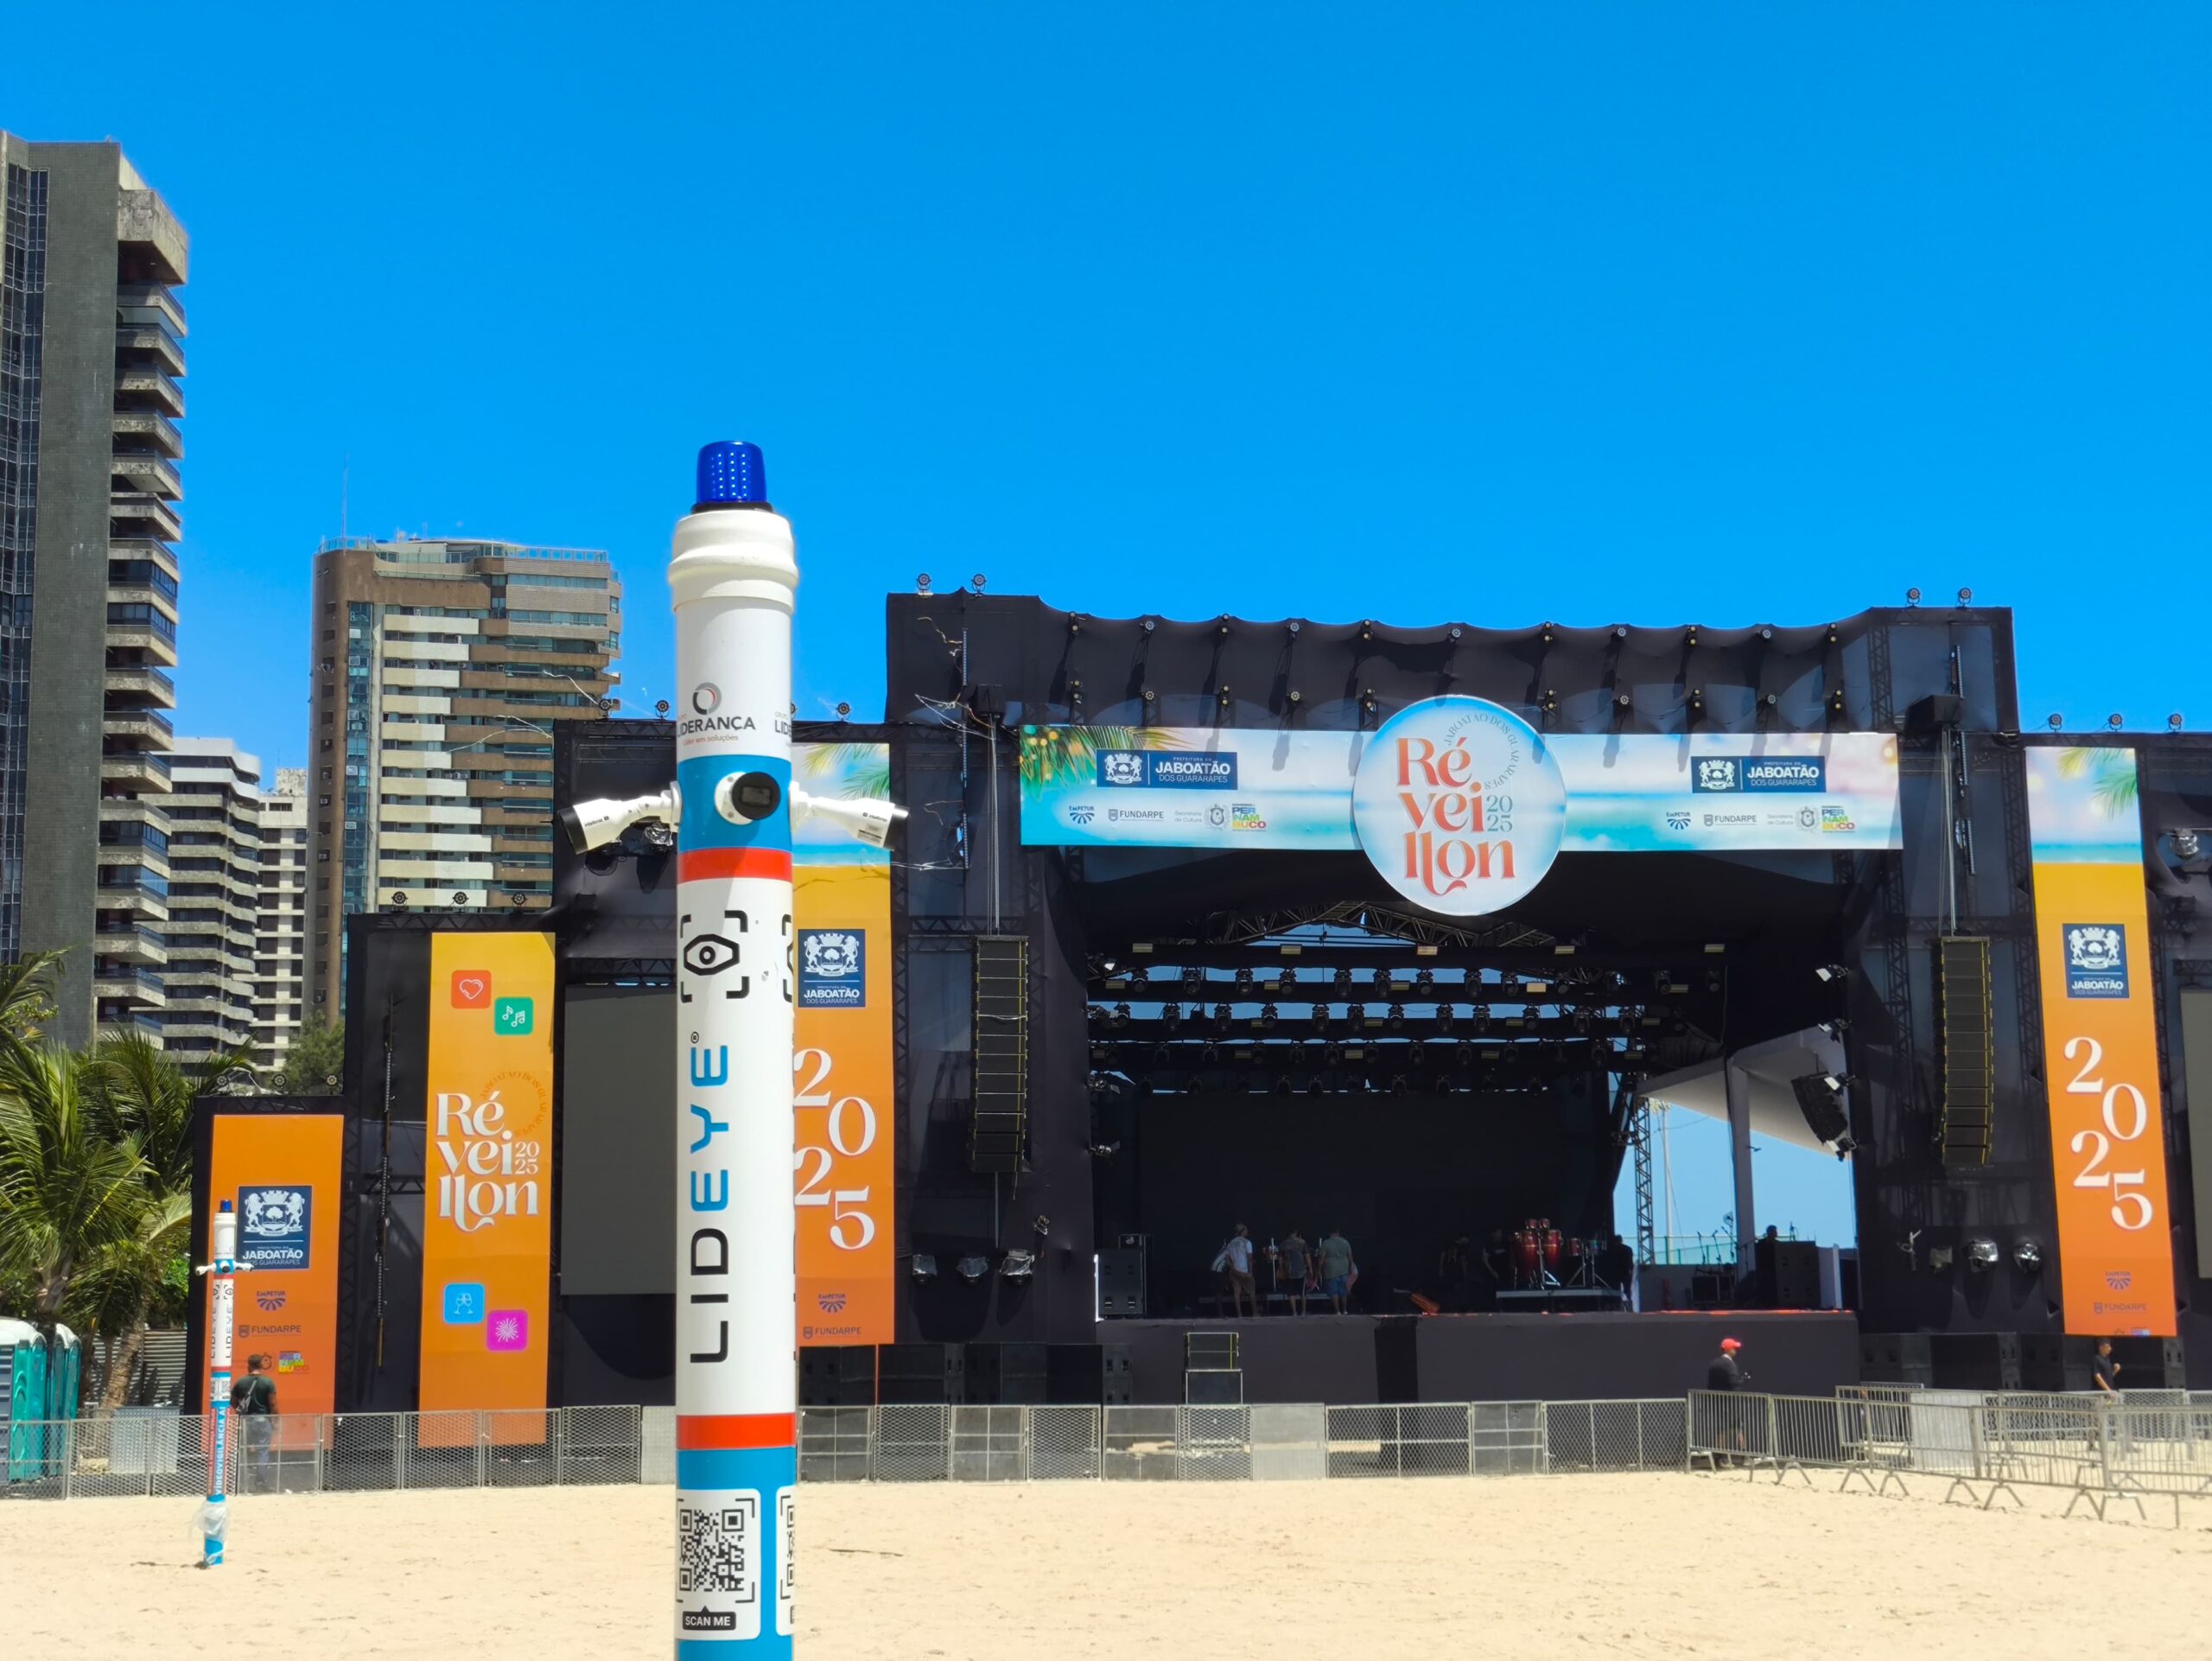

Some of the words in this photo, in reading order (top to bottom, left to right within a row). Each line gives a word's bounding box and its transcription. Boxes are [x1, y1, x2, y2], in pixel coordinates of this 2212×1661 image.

[1155, 760, 1230, 775] JABOATÃO
[1396, 736, 1472, 788] Ré
[1159, 773, 1175, 782] DOS
[1176, 774, 1229, 783] GUARARAPES
[1747, 764, 1820, 779] JABOATÃO
[1397, 781, 1484, 832] vei
[1486, 795, 1513, 812] 20
[1120, 810, 1164, 819] FUNDARPE
[1486, 814, 1513, 832] 25
[2071, 980, 2124, 990] JABOATÃO
[804, 988, 860, 998] JABOATÃO
[436, 1091, 505, 1136] Ré
[436, 1130, 513, 1175] vei
[515, 1141, 540, 1158] 20
[515, 1158, 539, 1175] 25
[690, 1045, 729, 1363] LIDEYE
[242, 1248, 304, 1260] JABOATÃO
[251, 1325, 302, 1333] FUNDARPE
[815, 1327, 862, 1335] FUNDARPE
[684, 1615, 711, 1627] SCAN
[713, 1615, 731, 1627] ME
